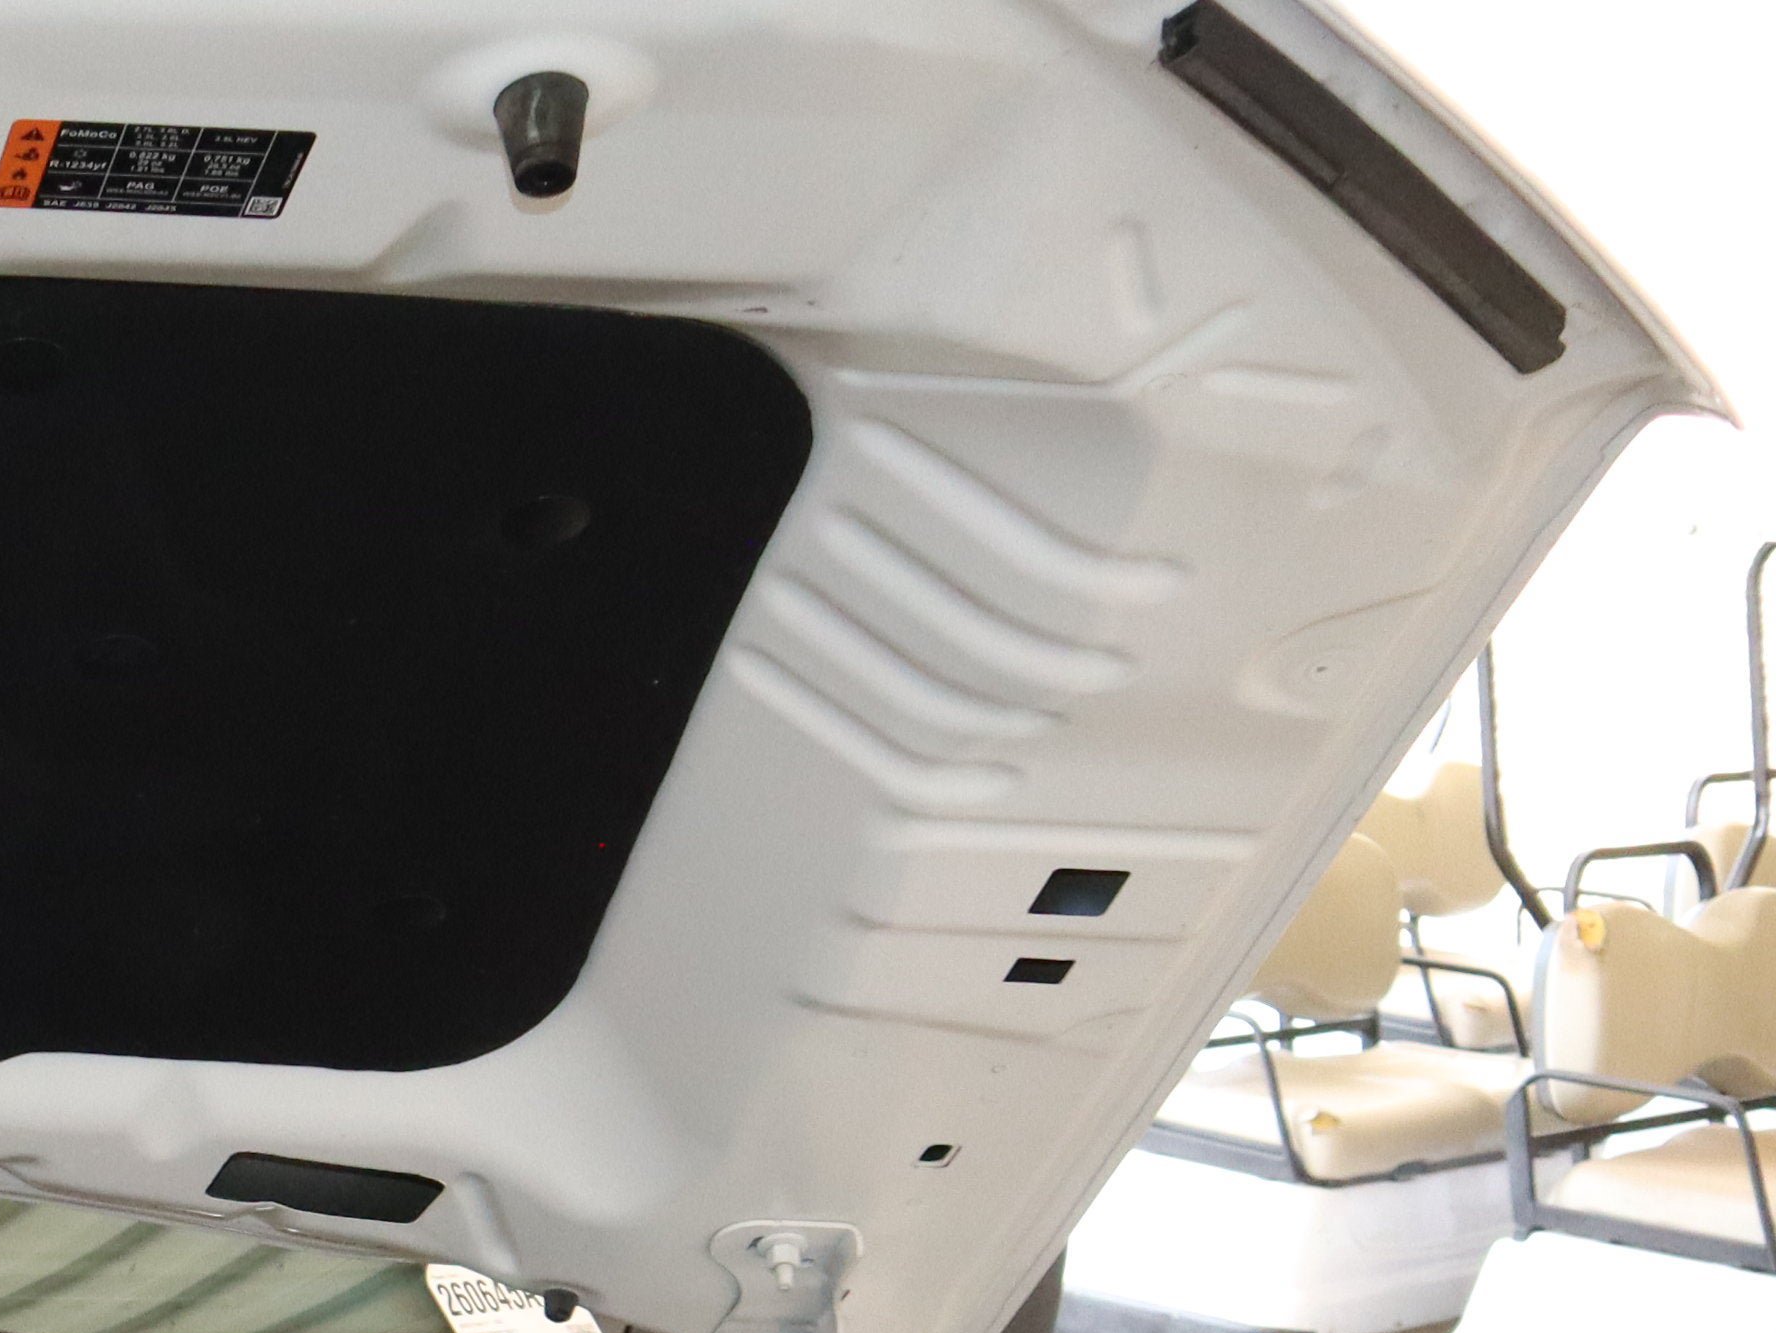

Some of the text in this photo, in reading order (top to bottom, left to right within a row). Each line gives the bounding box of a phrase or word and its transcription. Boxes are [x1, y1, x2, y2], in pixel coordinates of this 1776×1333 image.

[60, 128, 118, 140] FoMoCo
[48, 160, 108, 172] R-1234yf
[125, 181, 156, 190] PAG
[199, 184, 229, 194] POE
